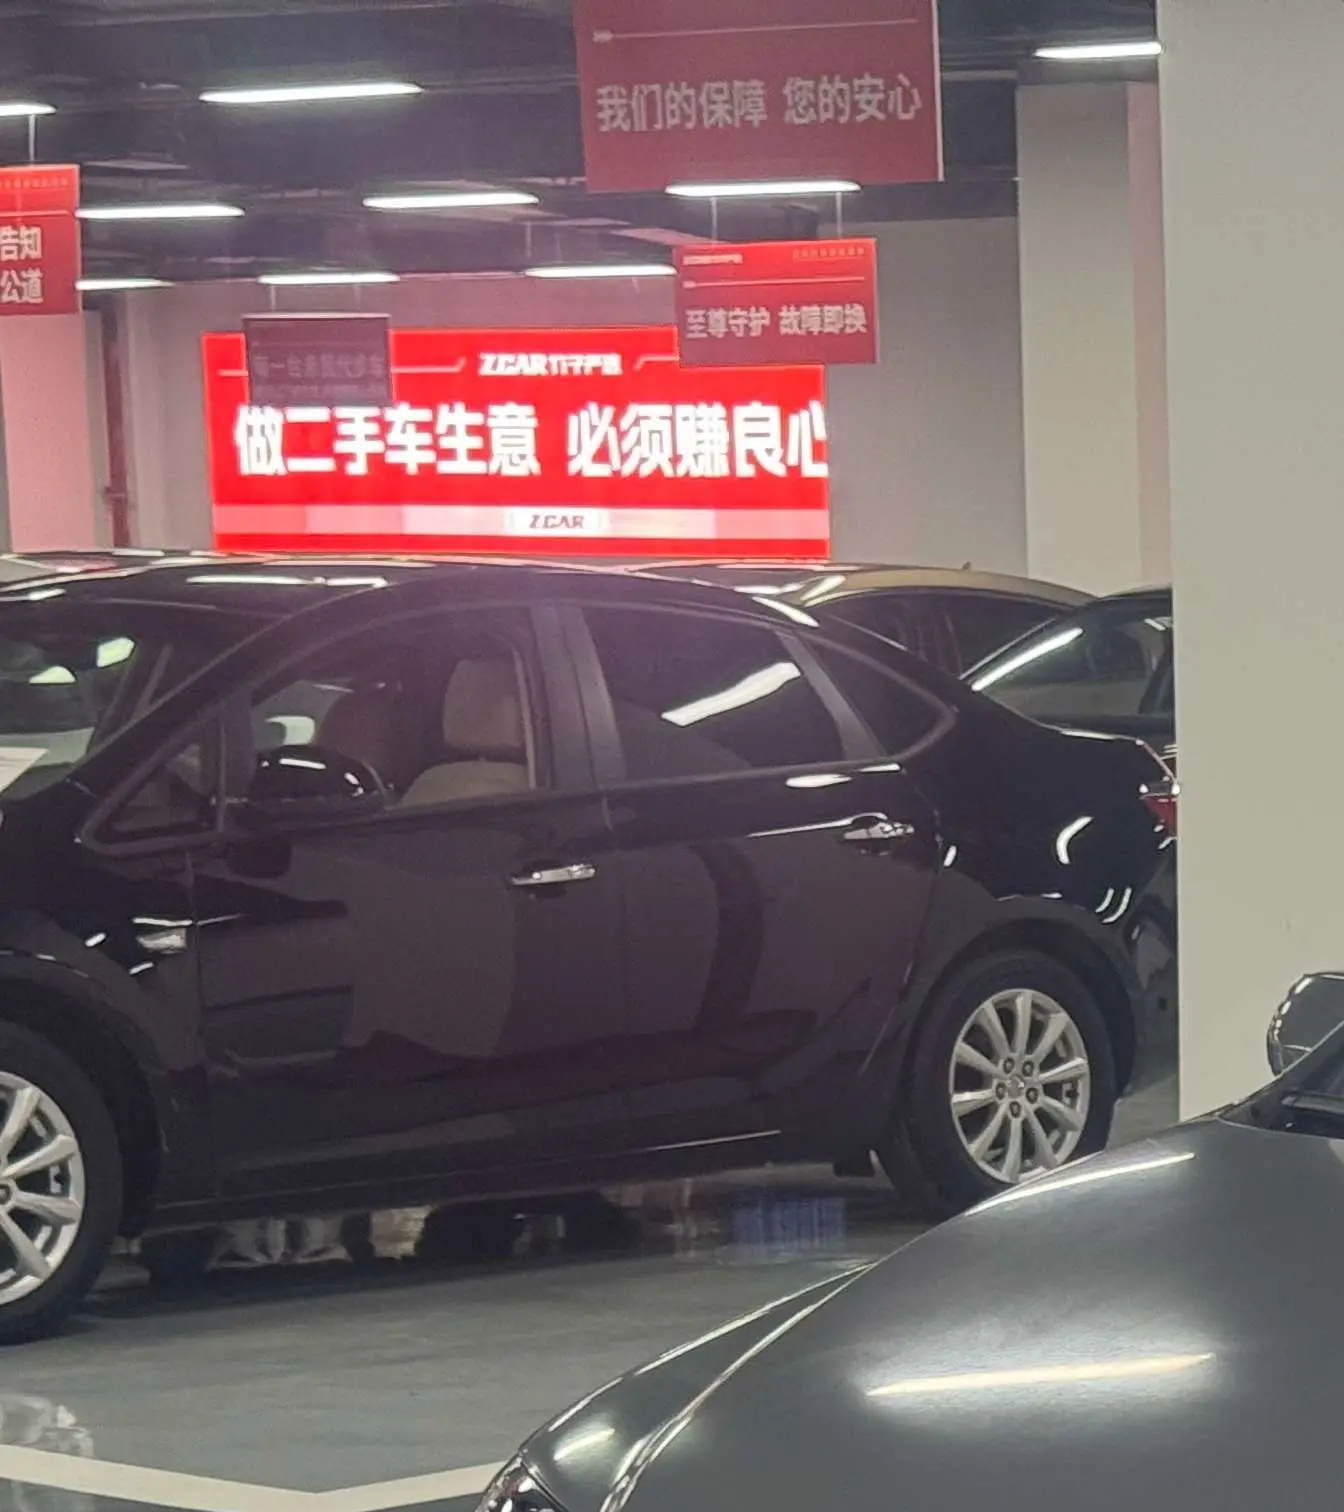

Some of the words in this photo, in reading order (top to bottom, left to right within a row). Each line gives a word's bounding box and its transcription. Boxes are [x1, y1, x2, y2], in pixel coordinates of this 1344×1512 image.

[595, 79, 768, 132] 我们的保障
[782, 72, 922, 125] 您的安心
[0, 267, 44, 304] 公道
[685, 305, 770, 339] 至尊守护
[778, 302, 868, 336] 故障即换
[234, 401, 542, 477] 做二手车生意
[567, 399, 829, 479] 必须赚良心
[528, 514, 585, 530] ZCAR
